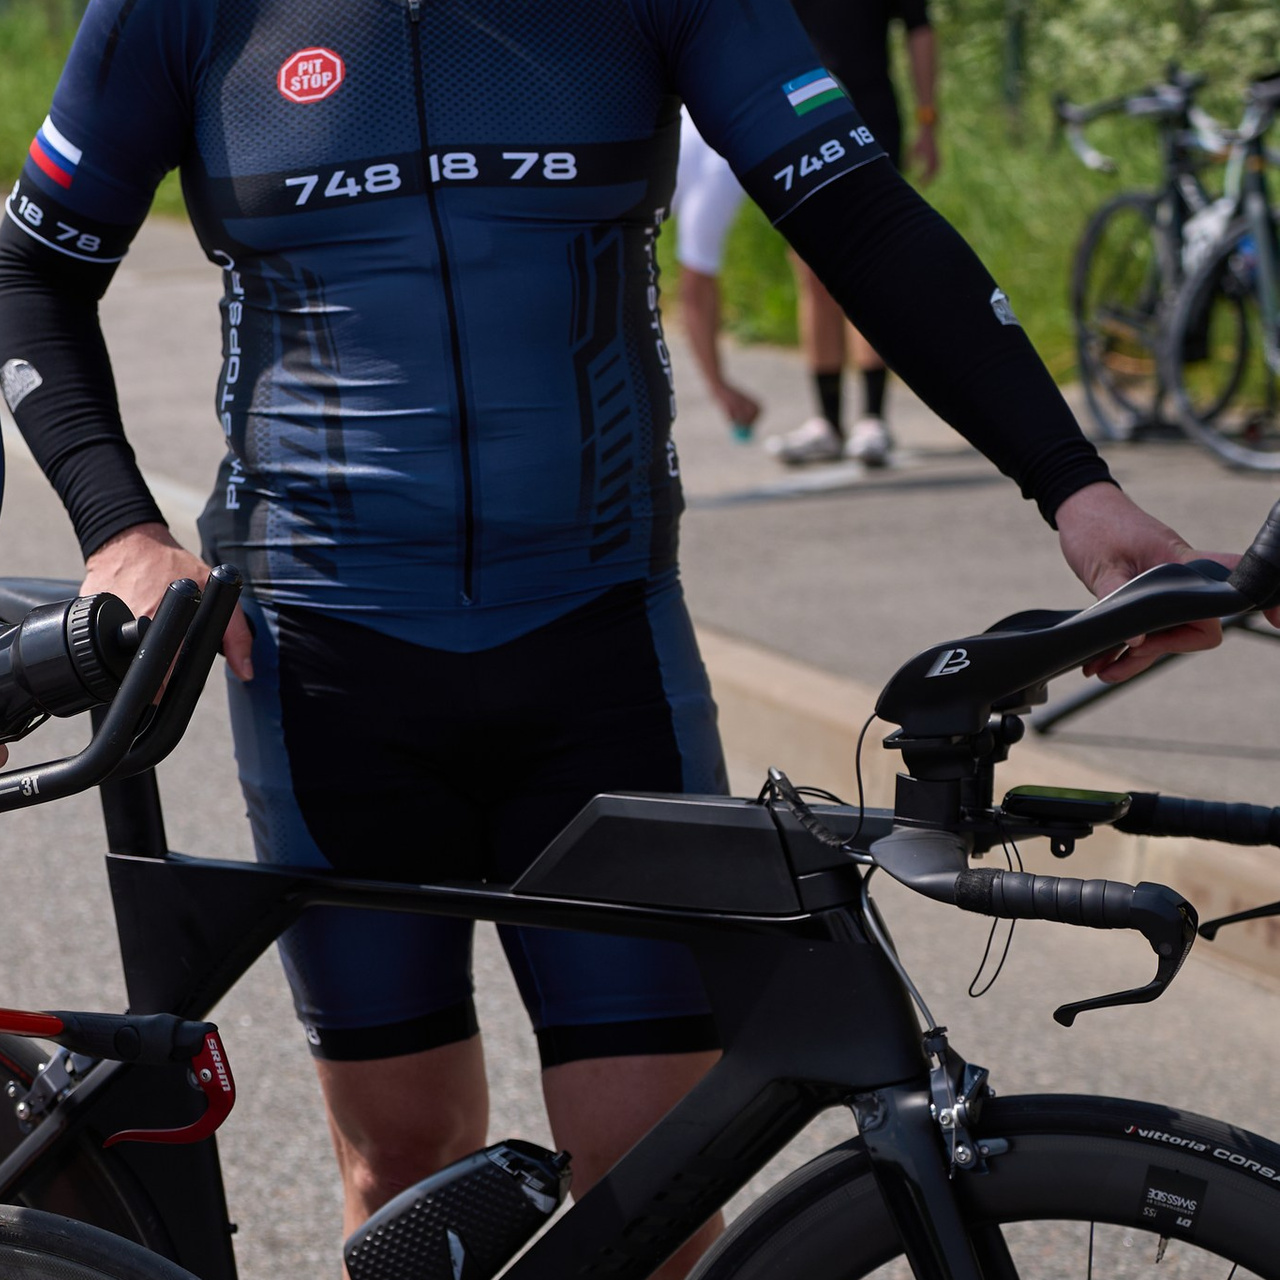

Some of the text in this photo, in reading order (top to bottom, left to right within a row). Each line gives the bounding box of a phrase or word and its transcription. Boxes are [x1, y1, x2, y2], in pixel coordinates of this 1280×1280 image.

[290, 73, 333, 92] STOP
[285, 152, 577, 206] 748 18 78
[773, 125, 875, 192] 748 18
[18, 195, 101, 252] 18 78
[21, 775, 40, 797] 3T
[207, 1038, 232, 1092] SRAM
[1138, 1128, 1206, 1152] vittoria
